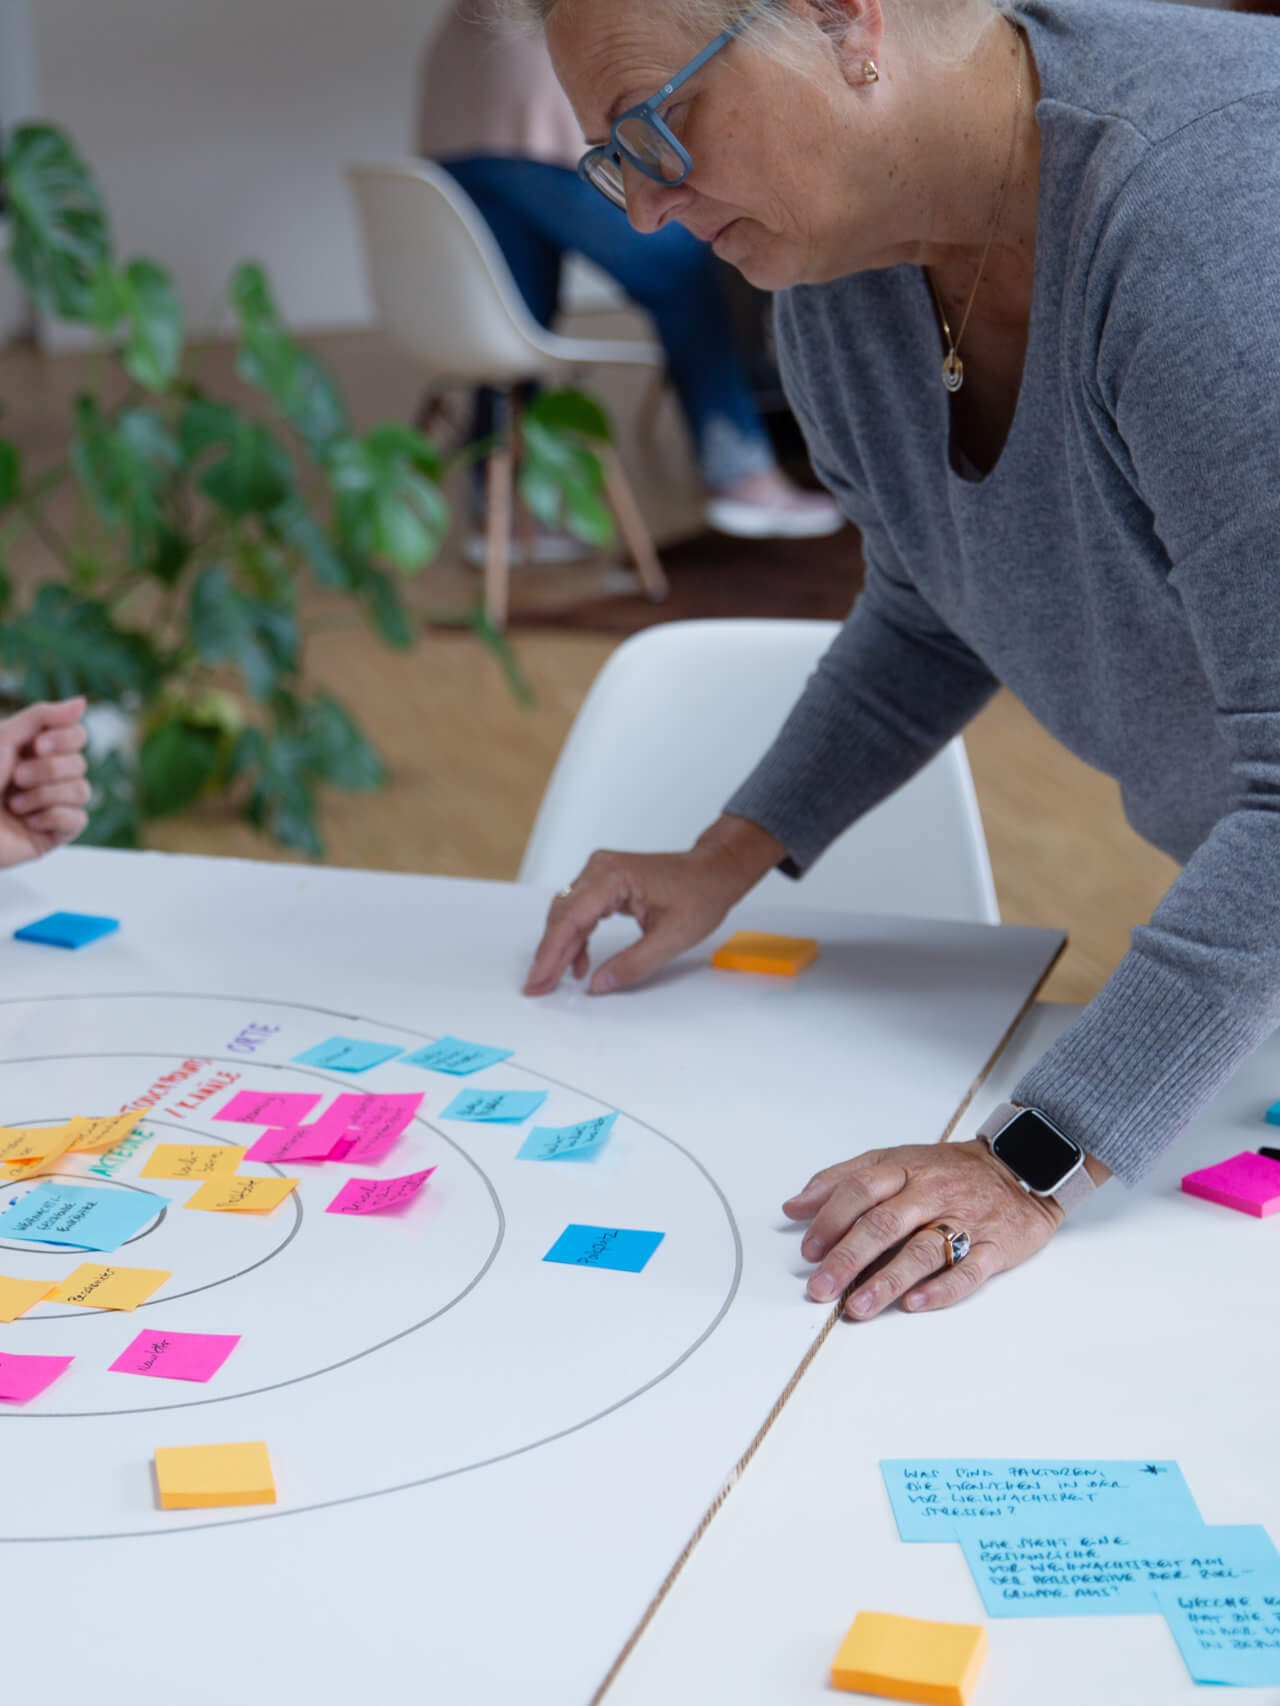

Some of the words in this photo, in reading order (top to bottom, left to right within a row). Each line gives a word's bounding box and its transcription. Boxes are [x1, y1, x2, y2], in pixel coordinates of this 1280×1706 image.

[226, 1021, 280, 1053] ORTE
[903, 1467, 940, 1479] WAS
[1079, 1535, 1129, 1548] EINE
